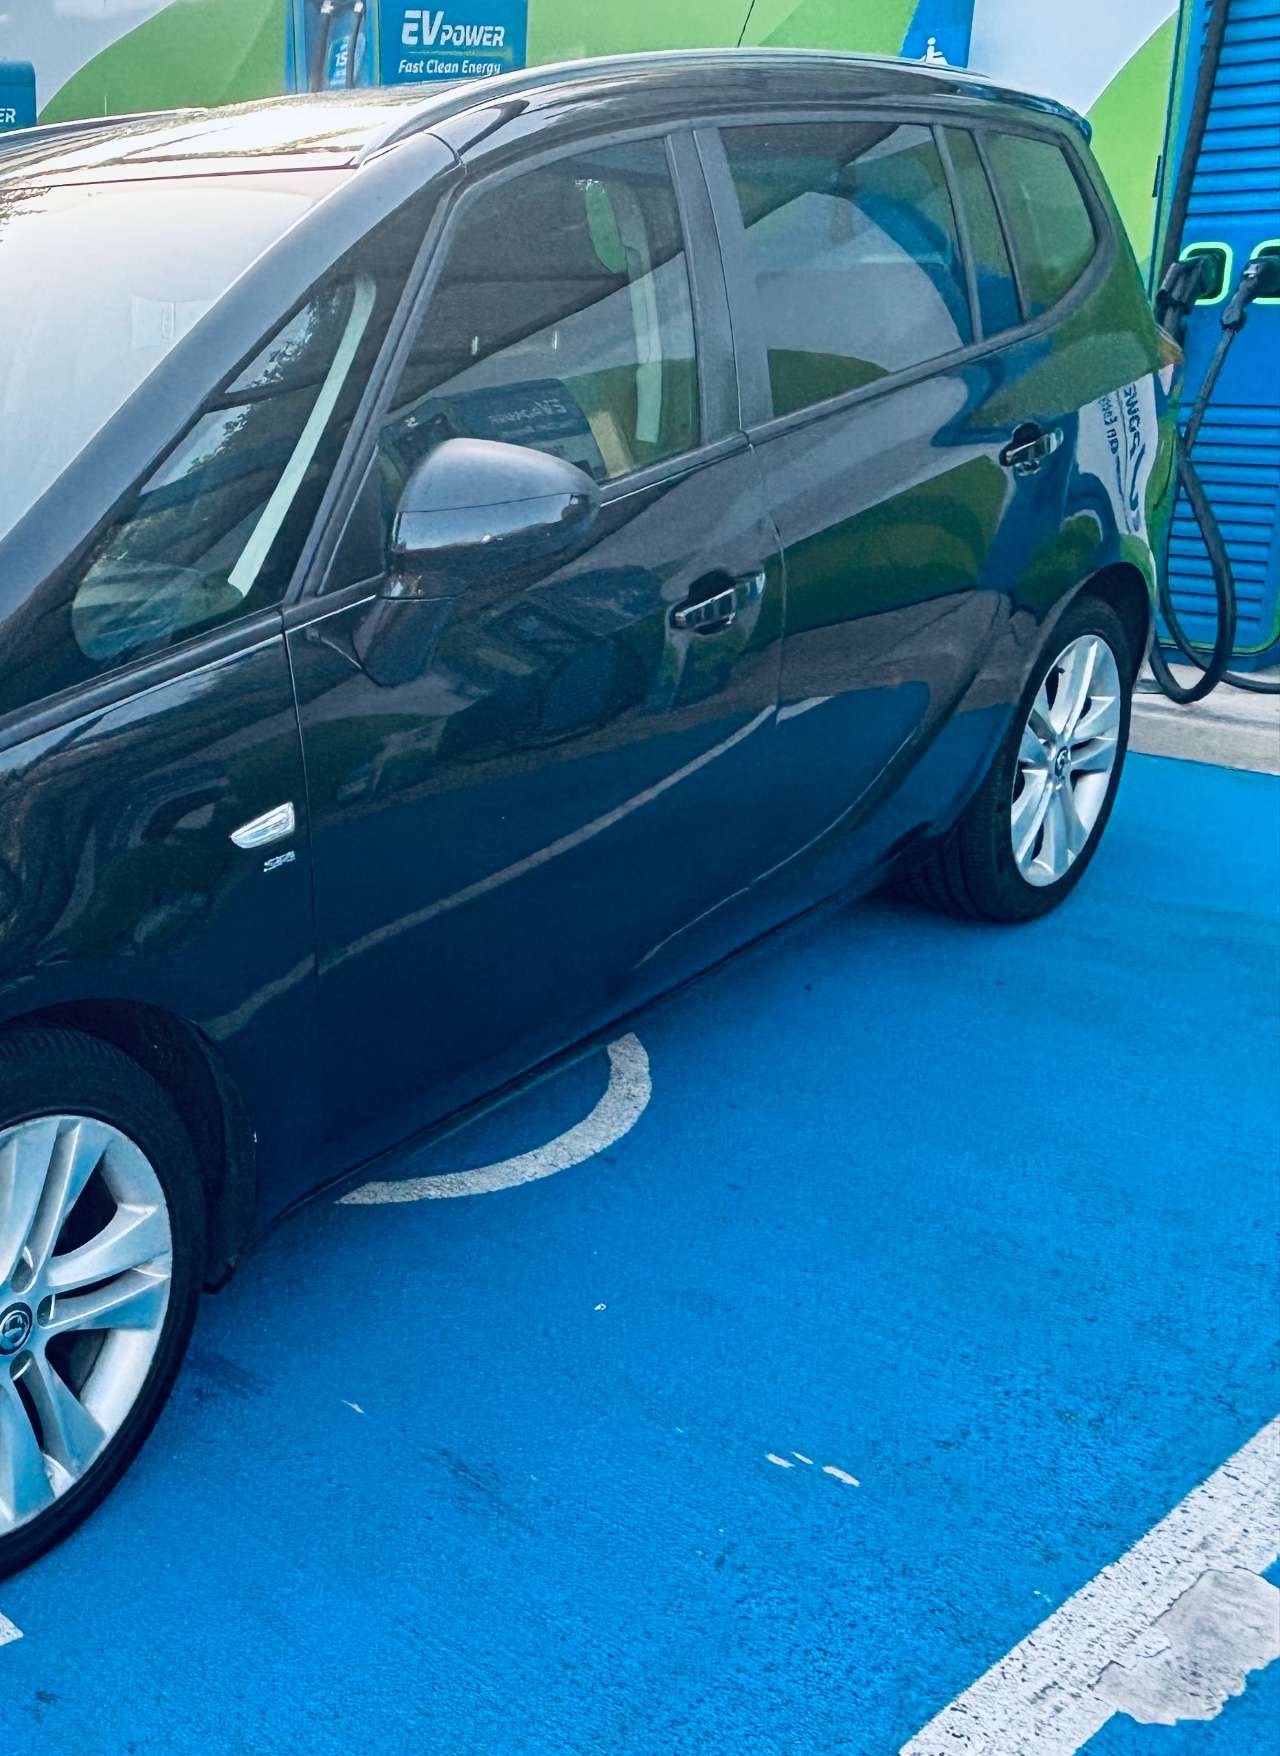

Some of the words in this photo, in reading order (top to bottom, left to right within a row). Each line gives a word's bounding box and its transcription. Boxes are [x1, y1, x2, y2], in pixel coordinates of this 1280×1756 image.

[398, 59, 424, 74] Fast
[426, 60, 459, 74] Clean
[462, 60, 501, 77] Energy
